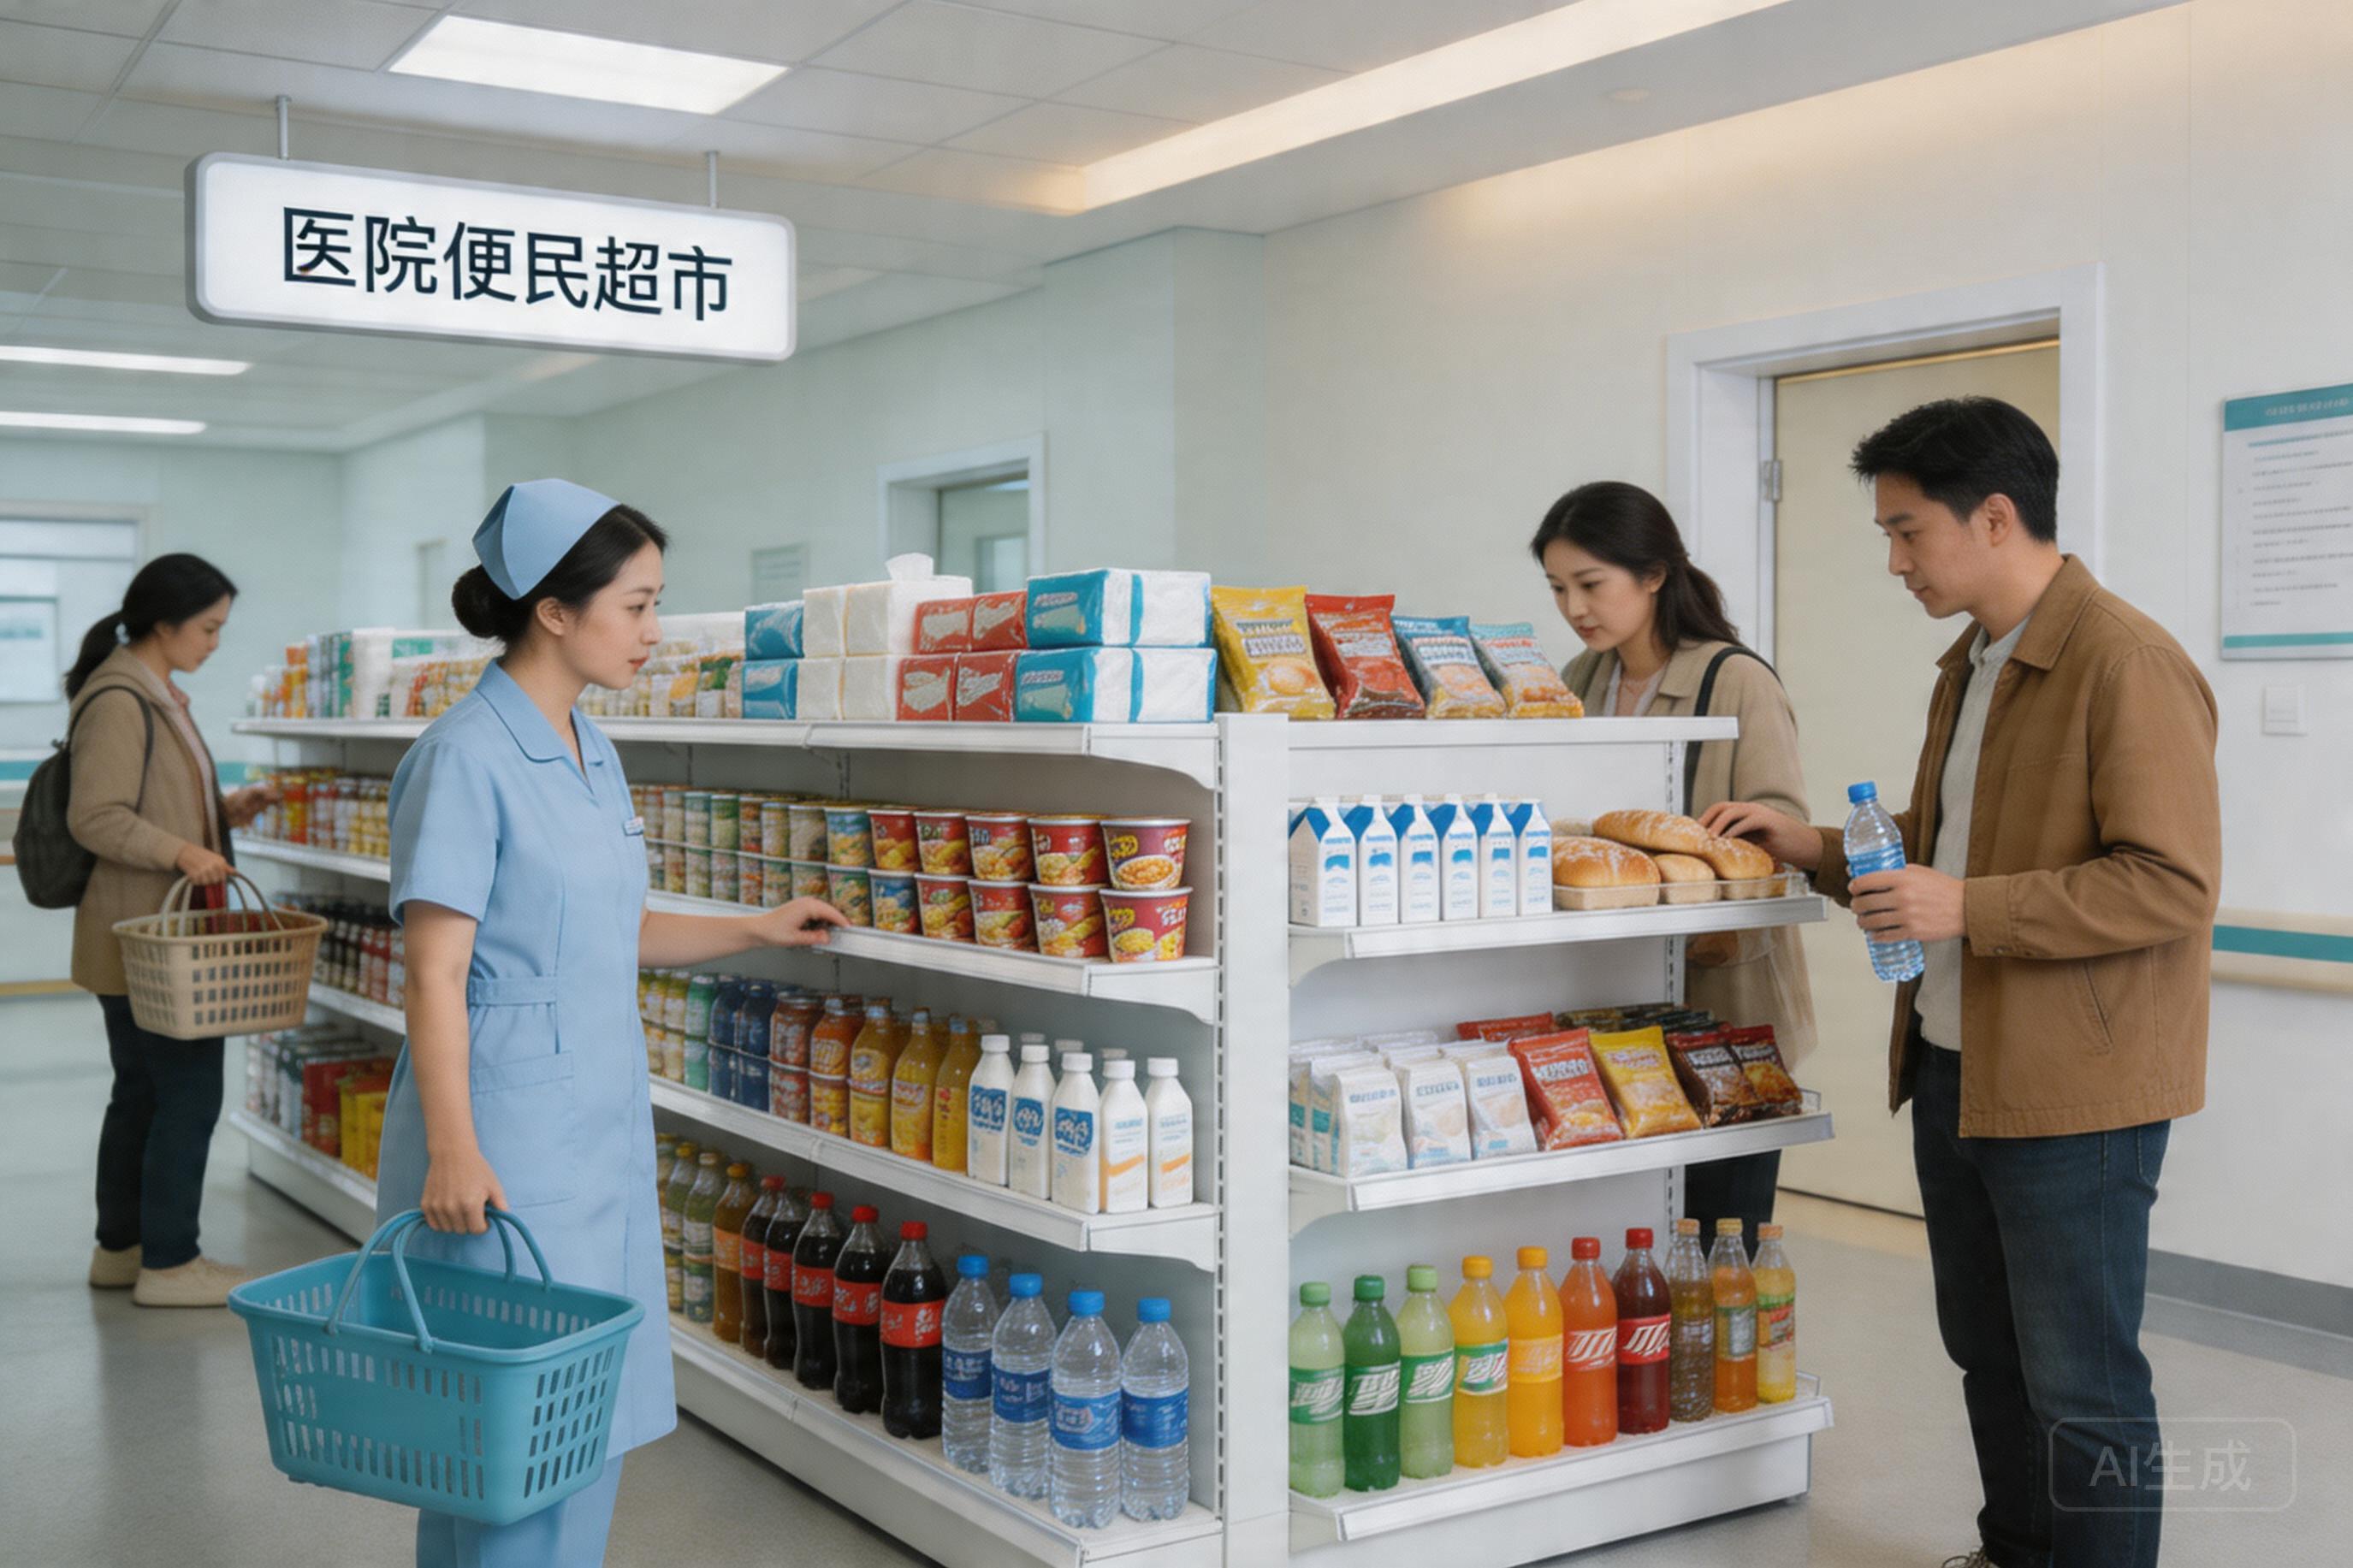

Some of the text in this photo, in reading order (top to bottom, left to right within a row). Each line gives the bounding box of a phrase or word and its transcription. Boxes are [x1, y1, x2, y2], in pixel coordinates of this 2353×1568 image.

[283, 207, 732, 321] 医院便民超市
